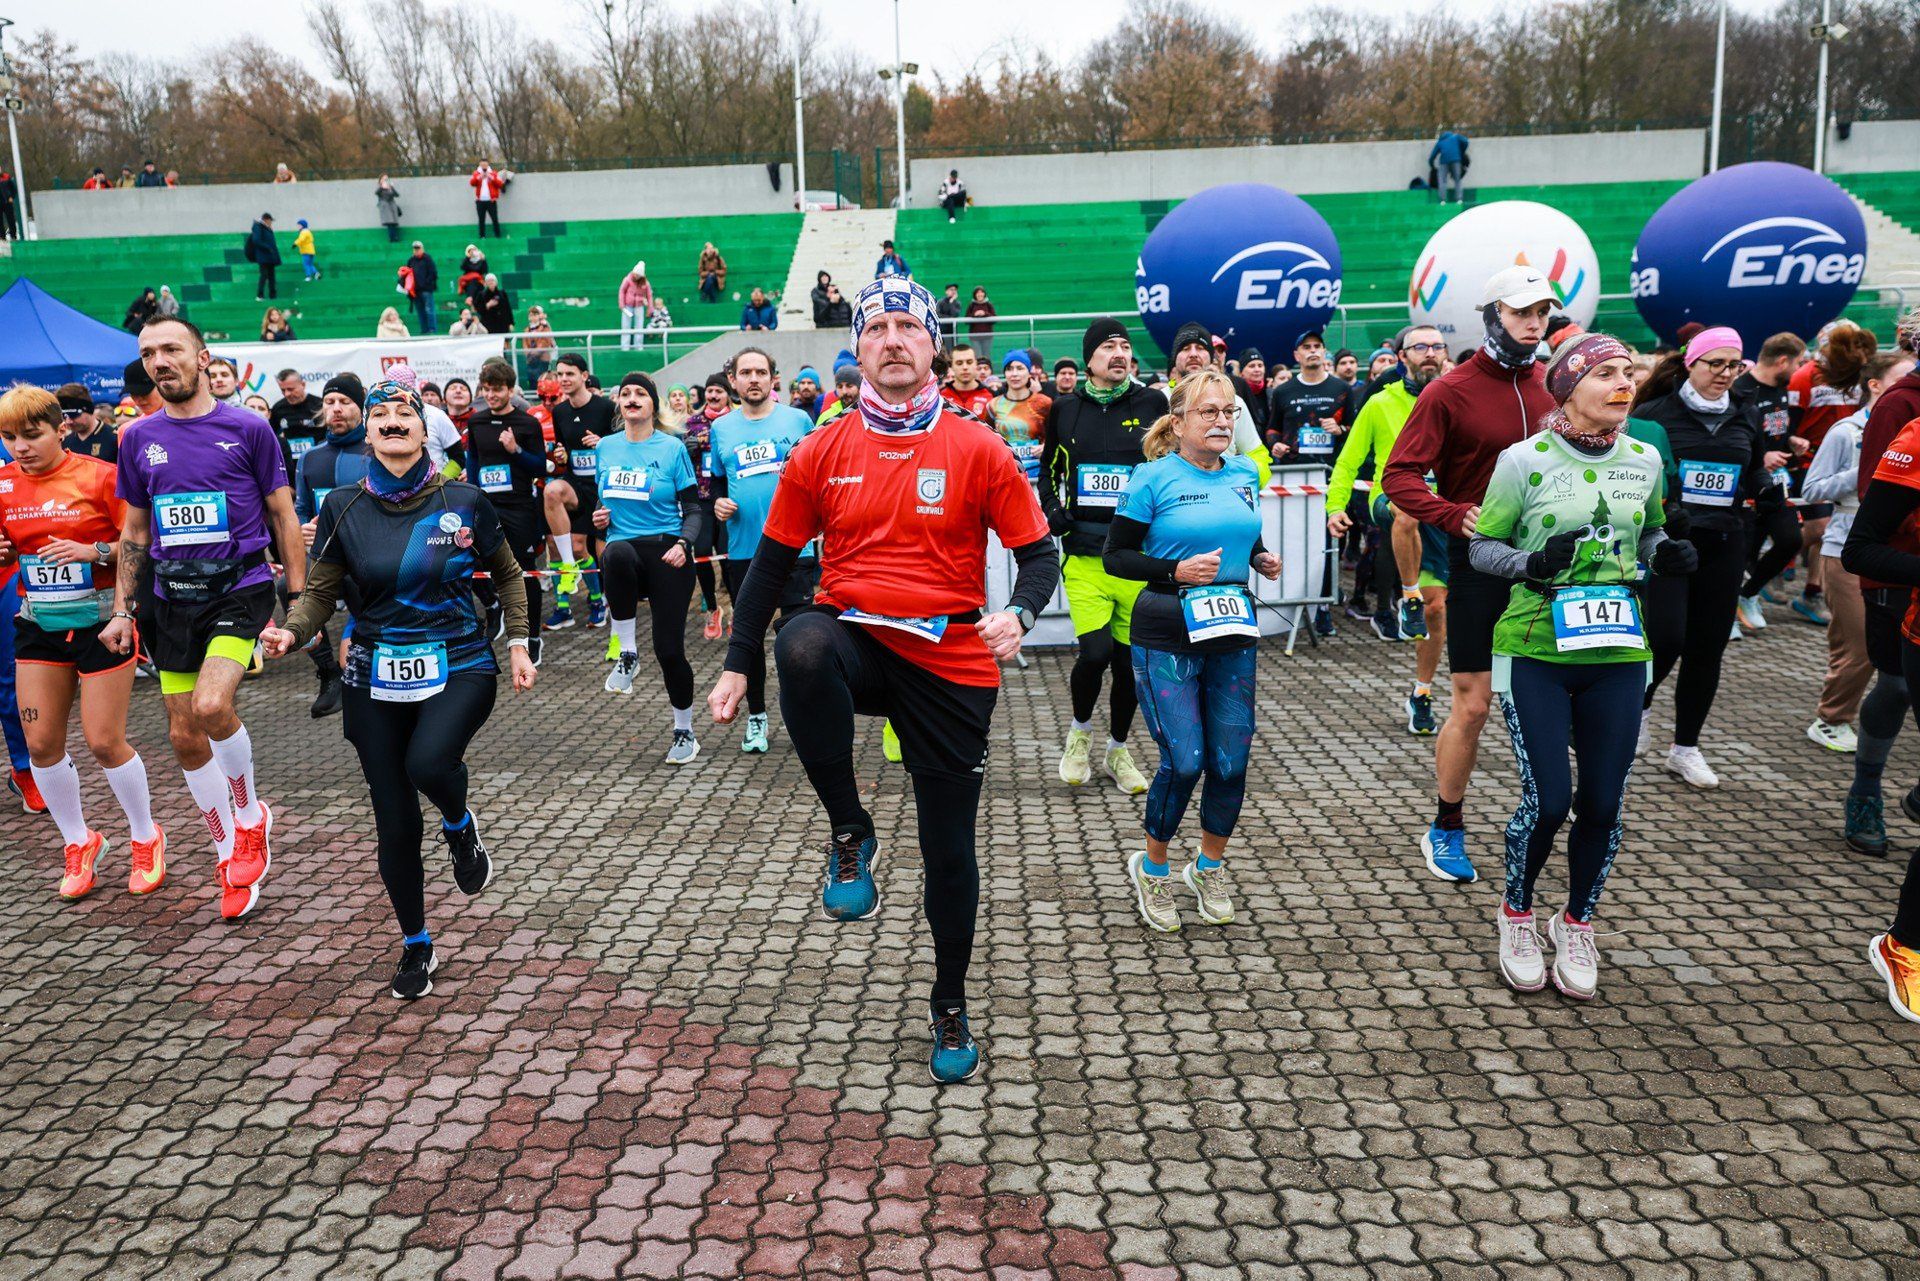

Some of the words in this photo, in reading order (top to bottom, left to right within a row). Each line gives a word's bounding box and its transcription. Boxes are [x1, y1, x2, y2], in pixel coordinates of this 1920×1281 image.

[1727, 244, 1865, 288] Enea
[1235, 269, 1342, 311] Enea
[576, 456, 592, 467] 631
[745, 445, 769, 462] 462
[484, 472, 501, 483] 632
[614, 472, 638, 486] 461
[1092, 474, 1120, 491] 380
[1608, 470, 1647, 481] Zielone
[1694, 472, 1726, 490] 988
[1179, 493, 1209, 503] Airpol
[18, 509, 81, 520] CHARYTATYWNY
[169, 505, 206, 527] 580
[37, 566, 72, 584] 574
[1204, 597, 1240, 617] 160
[1578, 601, 1622, 624] 147
[387, 658, 426, 681] 150
